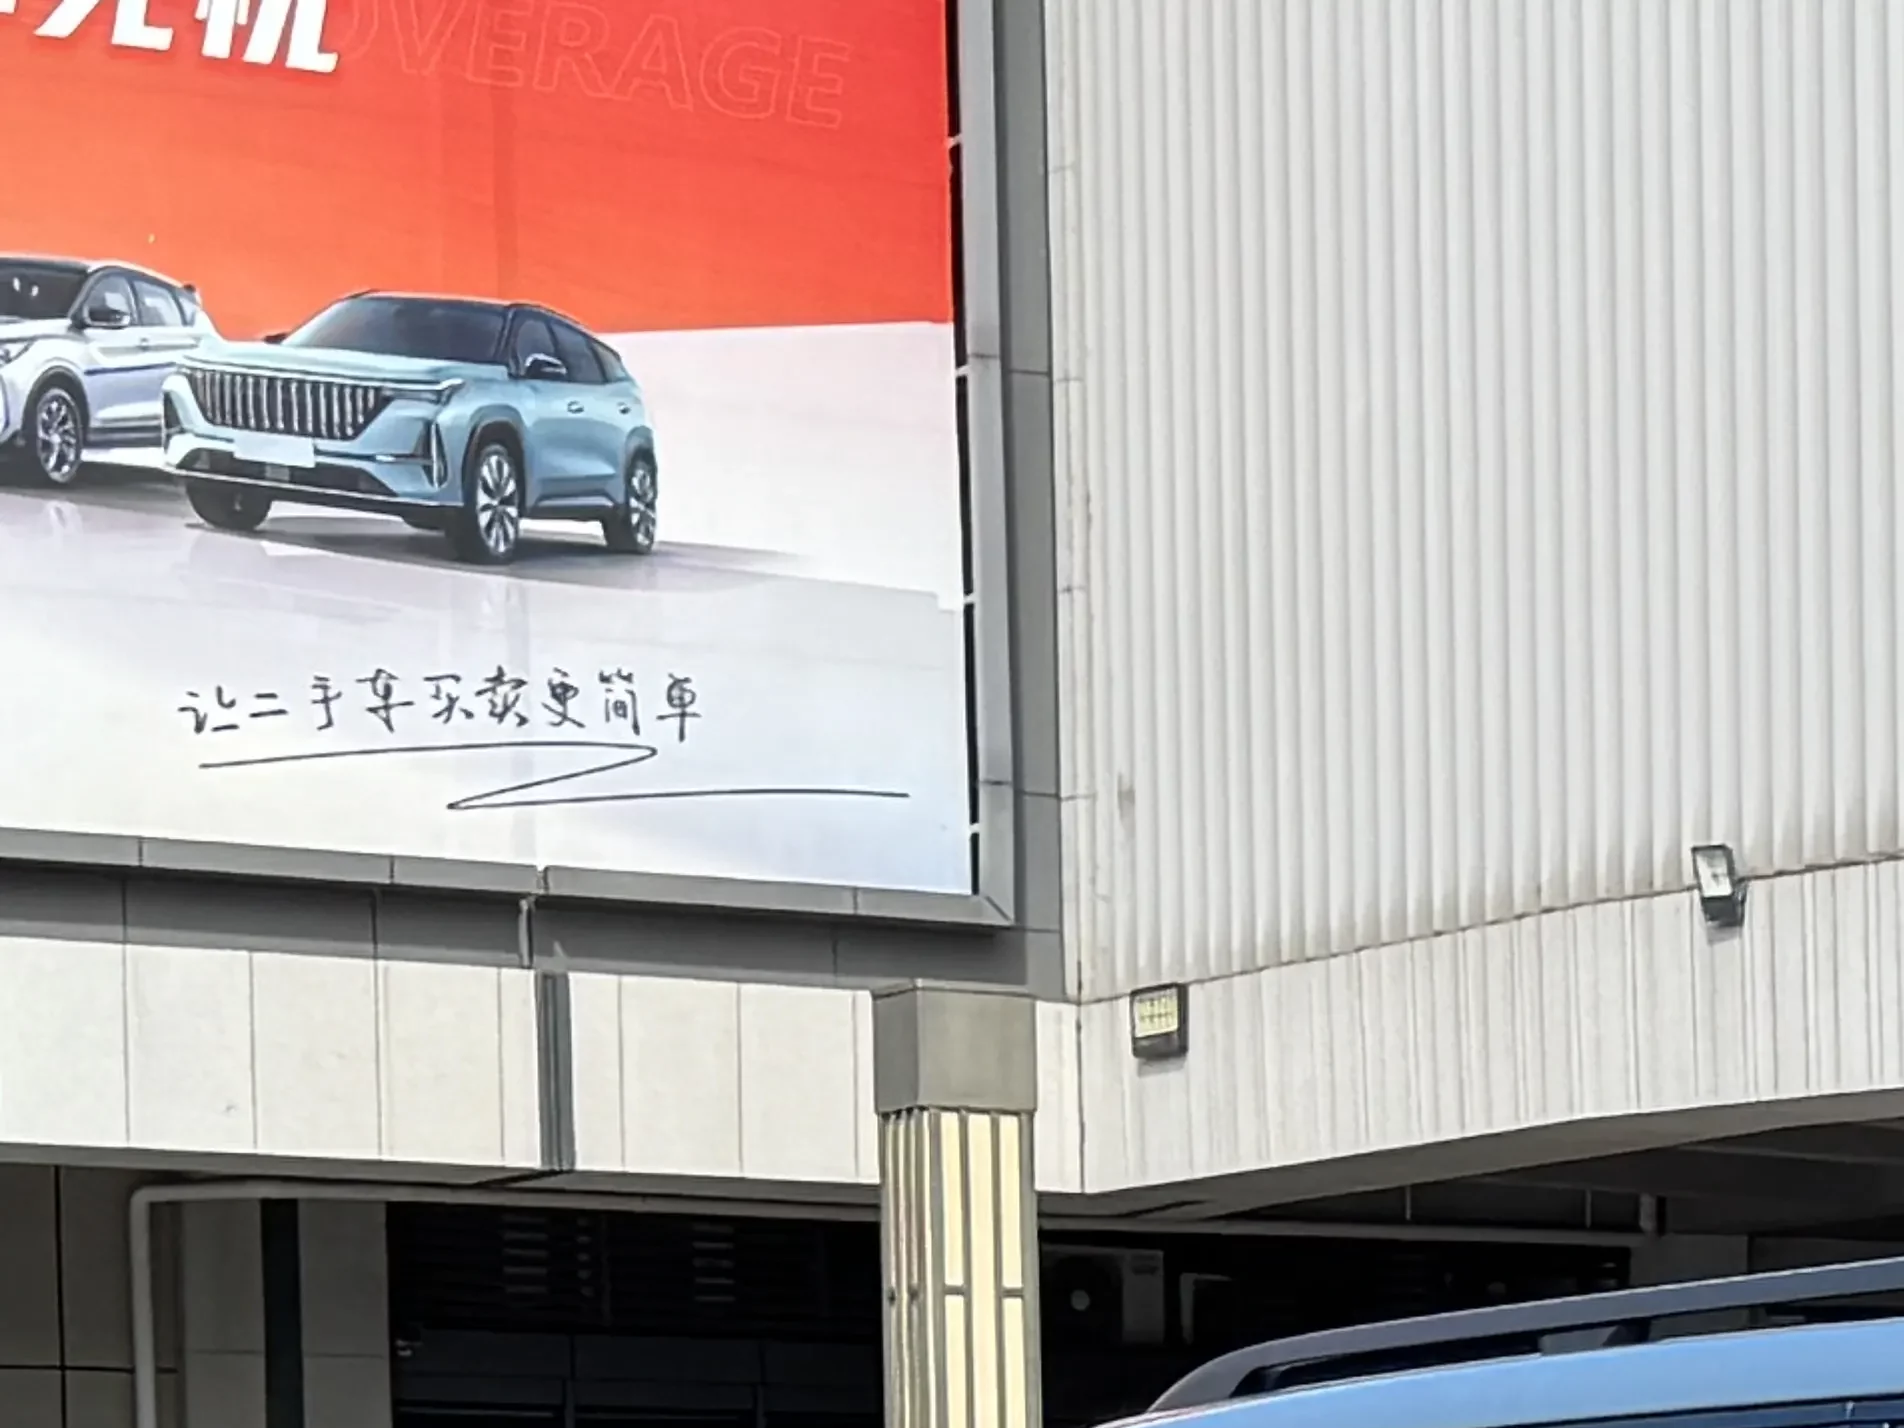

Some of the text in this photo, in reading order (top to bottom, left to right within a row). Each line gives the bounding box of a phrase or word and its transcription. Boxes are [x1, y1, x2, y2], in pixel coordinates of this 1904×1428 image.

[177, 665, 703, 742] 让二手车买卖更简单
